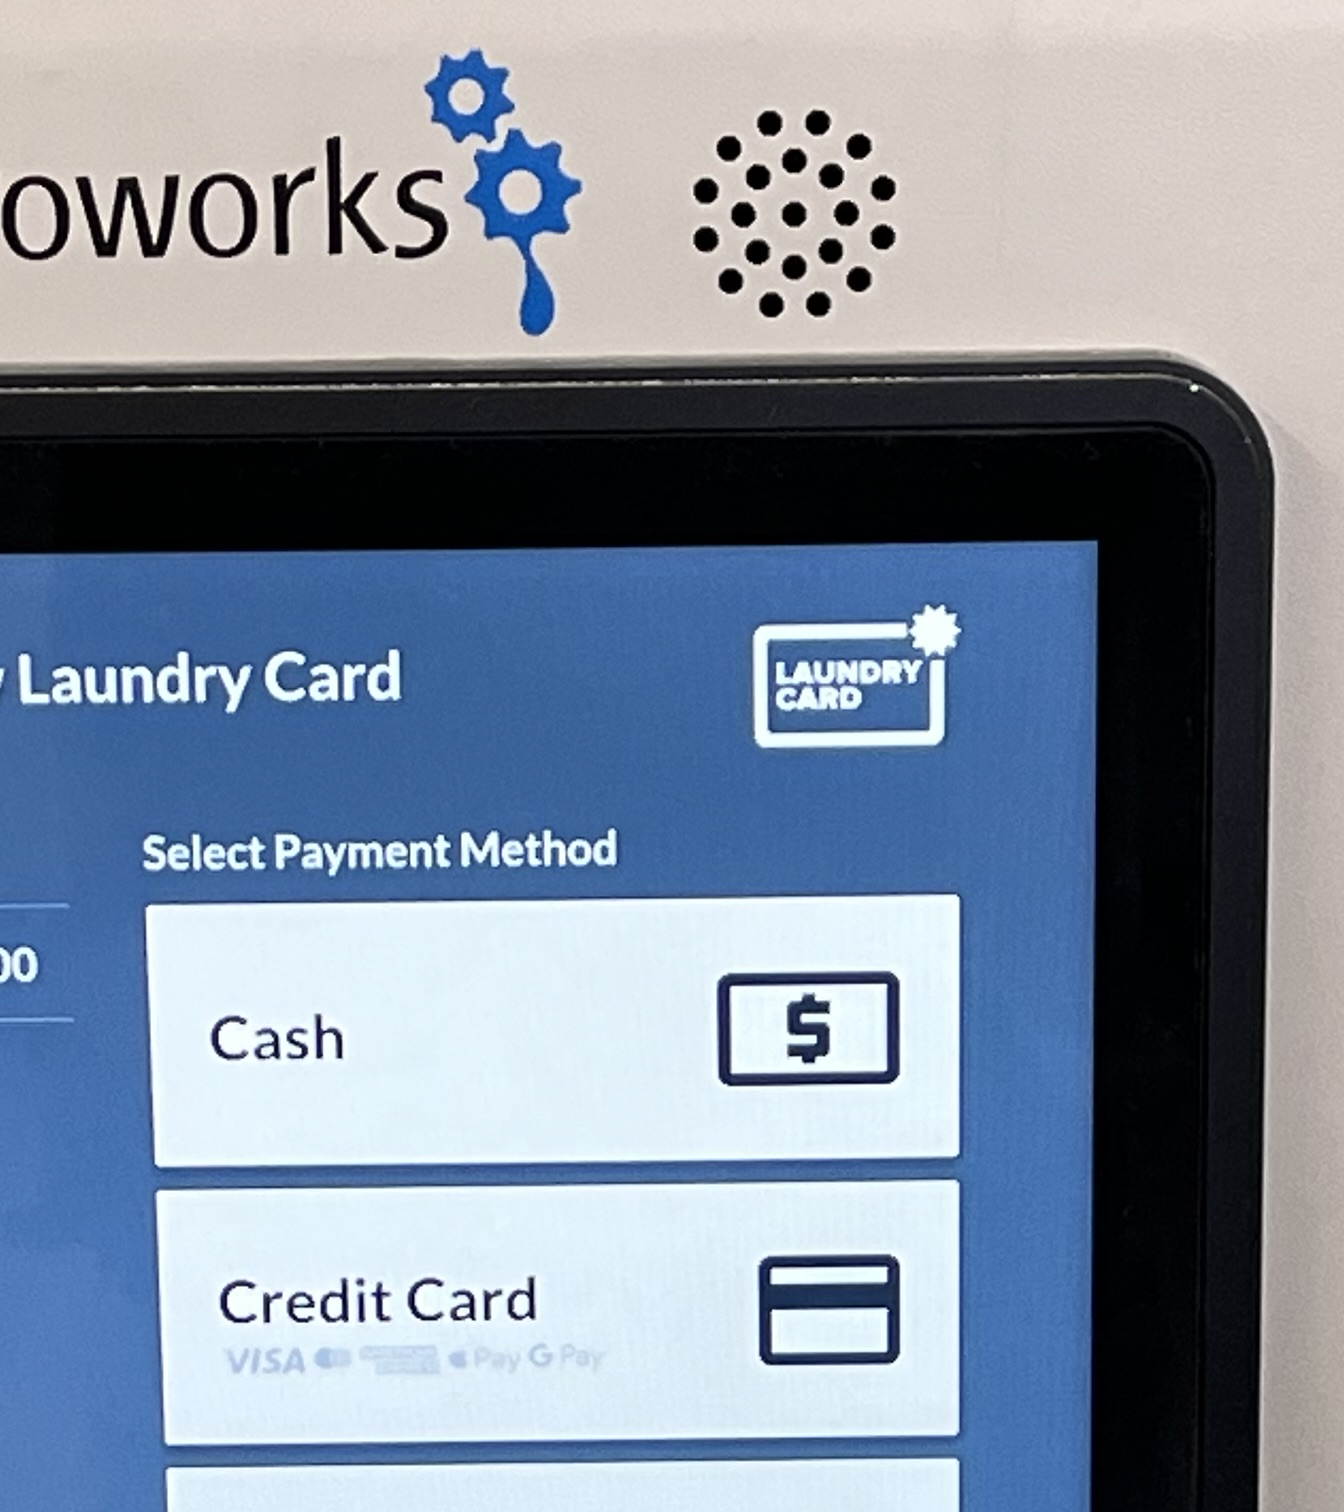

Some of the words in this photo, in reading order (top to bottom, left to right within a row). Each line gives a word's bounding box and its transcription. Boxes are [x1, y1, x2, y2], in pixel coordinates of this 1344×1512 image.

[18, 650, 253, 715] Laundry
[263, 648, 402, 704] Card
[775, 659, 924, 686] LAUNDRY
[775, 685, 863, 712] CARD
[142, 832, 267, 872] Select
[274, 833, 452, 878] Payment
[459, 827, 618, 869] Method
[210, 1012, 344, 1062] Cash
[219, 1276, 392, 1325] Credit
[406, 1275, 537, 1322] Card
[226, 1346, 307, 1375] VISA
[473, 1346, 520, 1374] Pay
[560, 1344, 605, 1374] Pay
